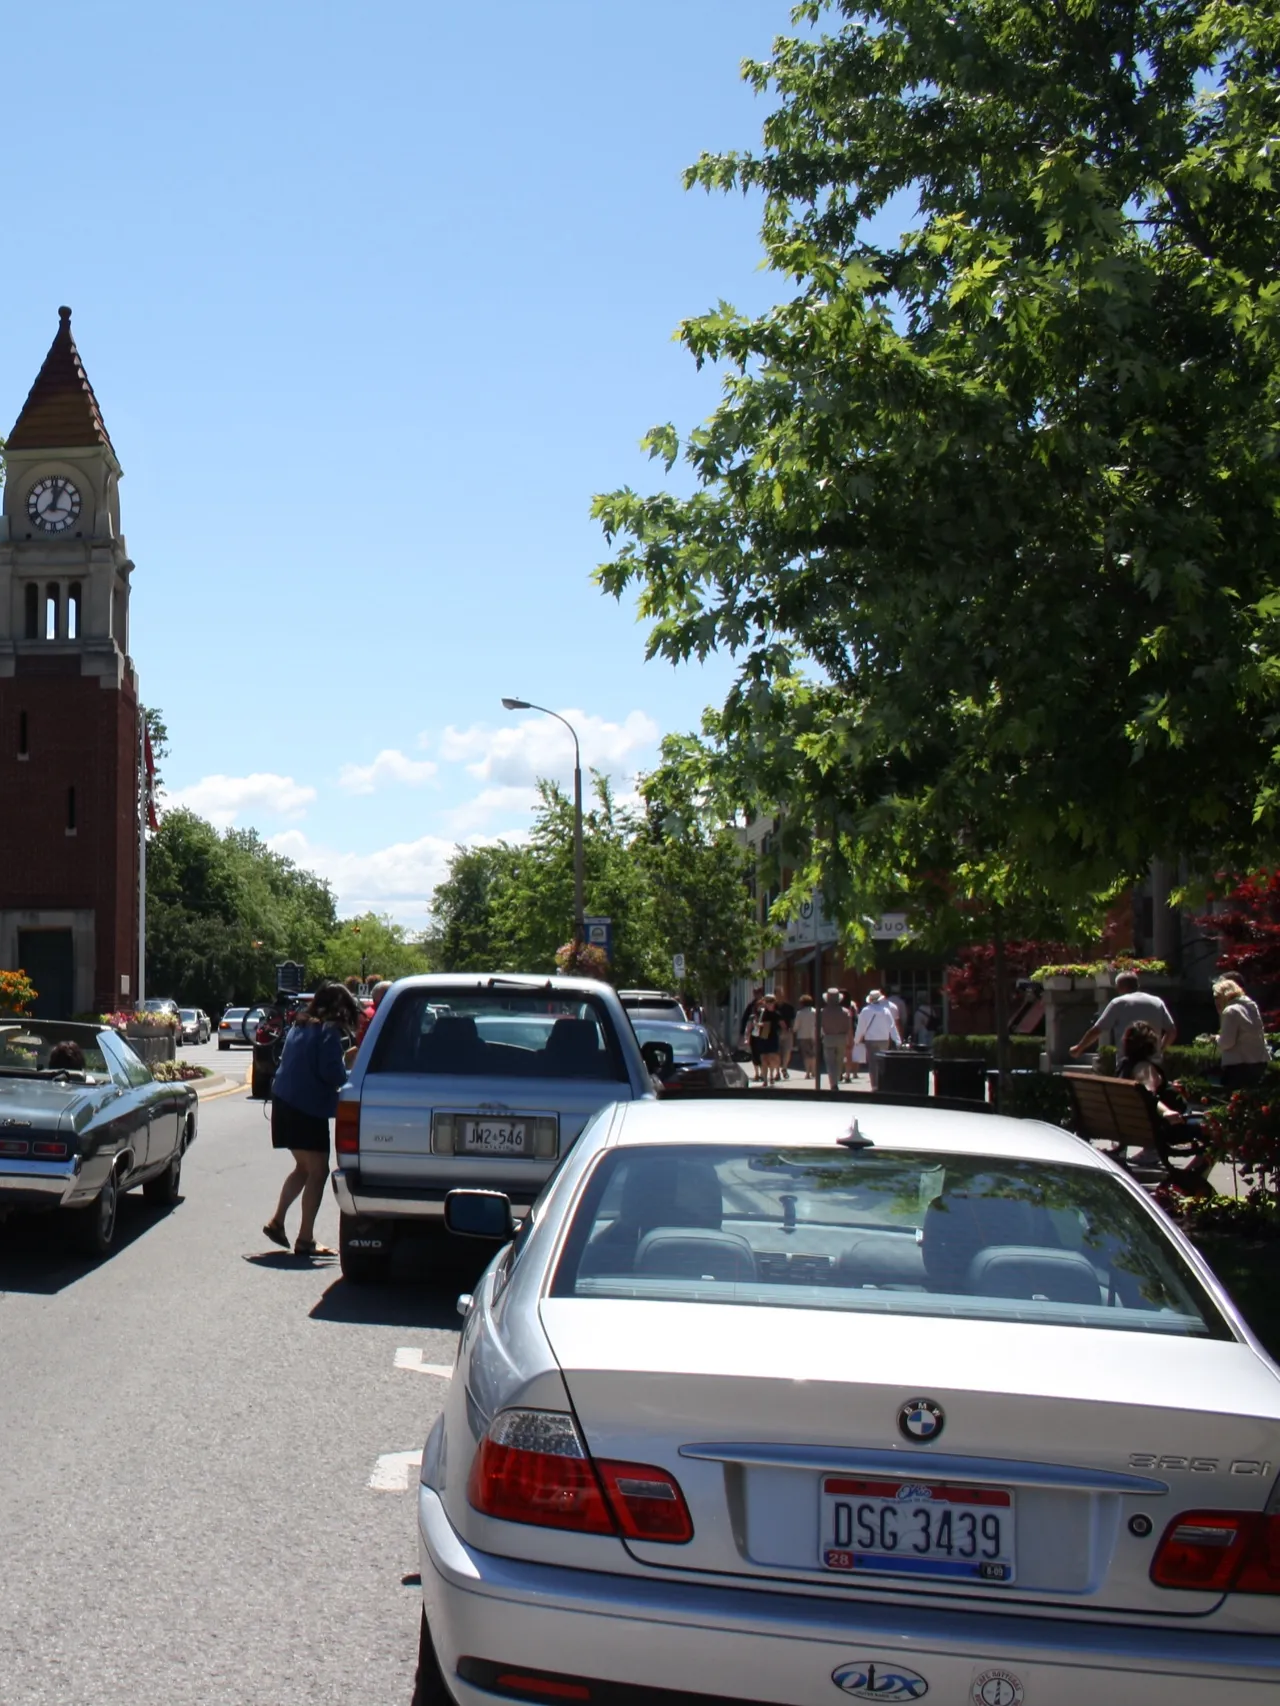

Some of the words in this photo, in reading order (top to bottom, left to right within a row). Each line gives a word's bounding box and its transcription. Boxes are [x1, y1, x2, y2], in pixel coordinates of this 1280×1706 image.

[468, 1128, 492, 1145] JW2
[499, 1128, 523, 1146] 546
[348, 1239, 382, 1248] 4WD
[903, 1402, 941, 1417] BMW
[834, 1502, 898, 1551] DSG
[911, 1508, 1001, 1560] 3439
[828, 1553, 849, 1566] 28
